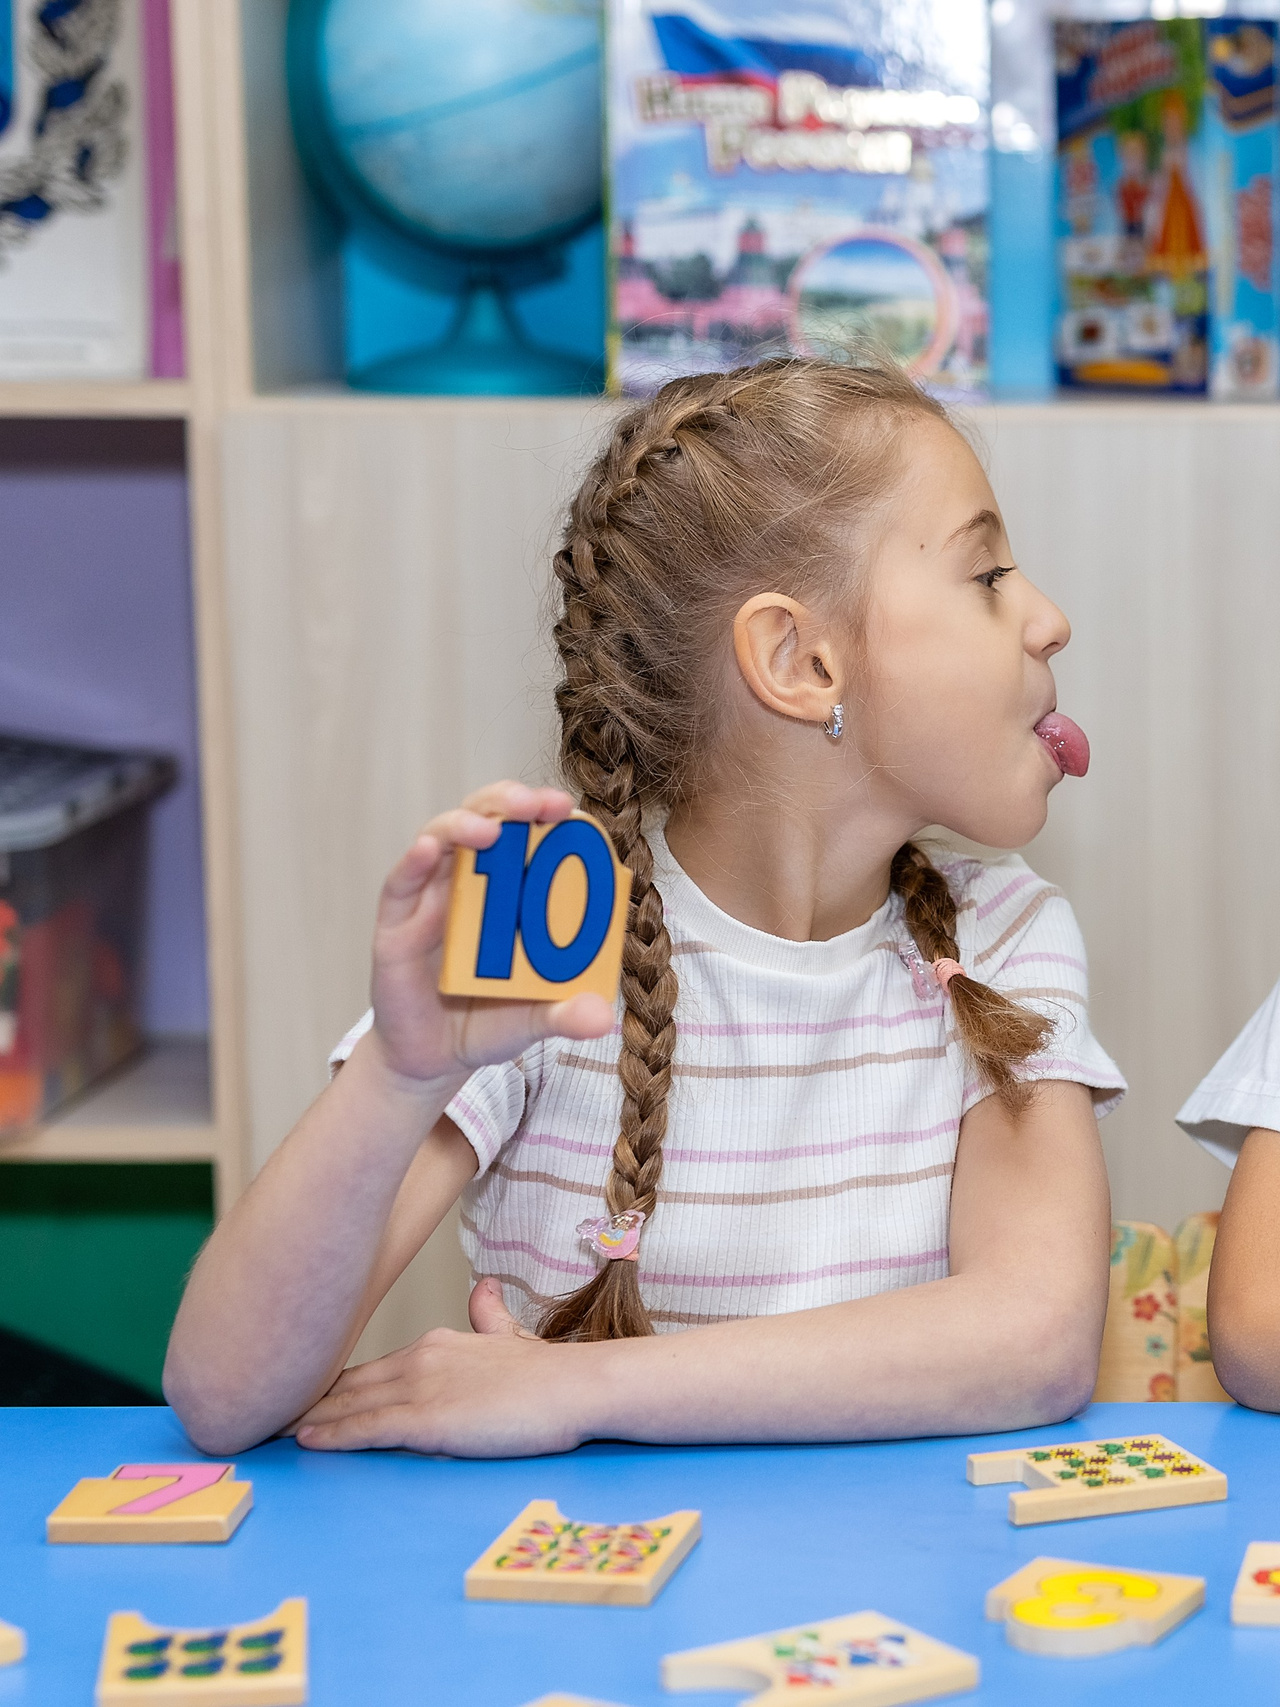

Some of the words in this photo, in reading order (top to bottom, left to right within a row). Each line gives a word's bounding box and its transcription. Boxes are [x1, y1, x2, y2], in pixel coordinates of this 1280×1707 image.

[475, 819, 616, 983] 10
[106, 1464, 231, 1514] 7
[1009, 1569, 1162, 1629] 3
